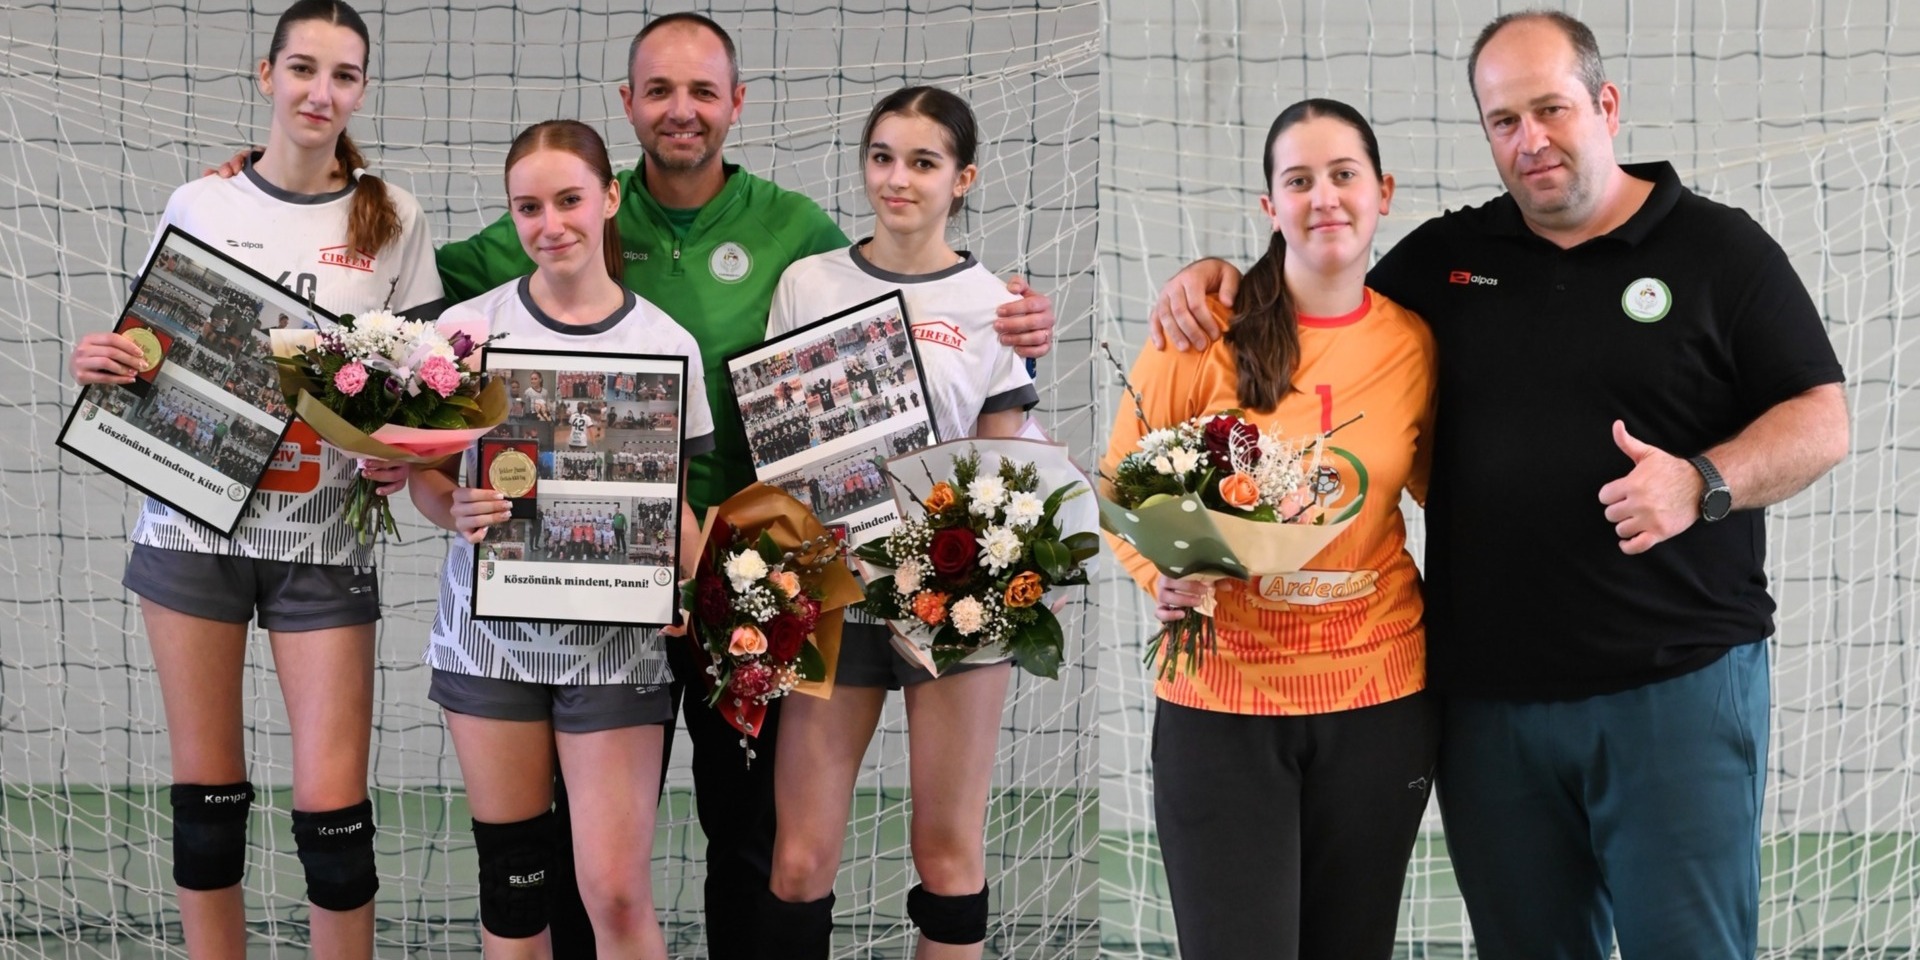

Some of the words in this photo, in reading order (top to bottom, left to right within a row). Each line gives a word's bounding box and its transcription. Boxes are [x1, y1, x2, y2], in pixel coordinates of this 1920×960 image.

[241, 241, 264, 249] alpas
[322, 252, 371, 269] CIRFEM
[623, 250, 648, 260] alpas
[1471, 275, 1498, 286] alpas
[912, 328, 962, 347] CIRFEM
[1315, 385, 1332, 434] 1
[97, 422, 152, 457] Köszönünk
[152, 452, 196, 482] mindent,
[197, 476, 224, 496] Kitti!
[504, 575, 562, 586] Köszönünk
[564, 577, 613, 588] mindent,
[614, 578, 649, 588] Panni!
[204, 792, 246, 804] Kempa
[317, 822, 363, 836] Kempa
[509, 870, 545, 884] SELECT
